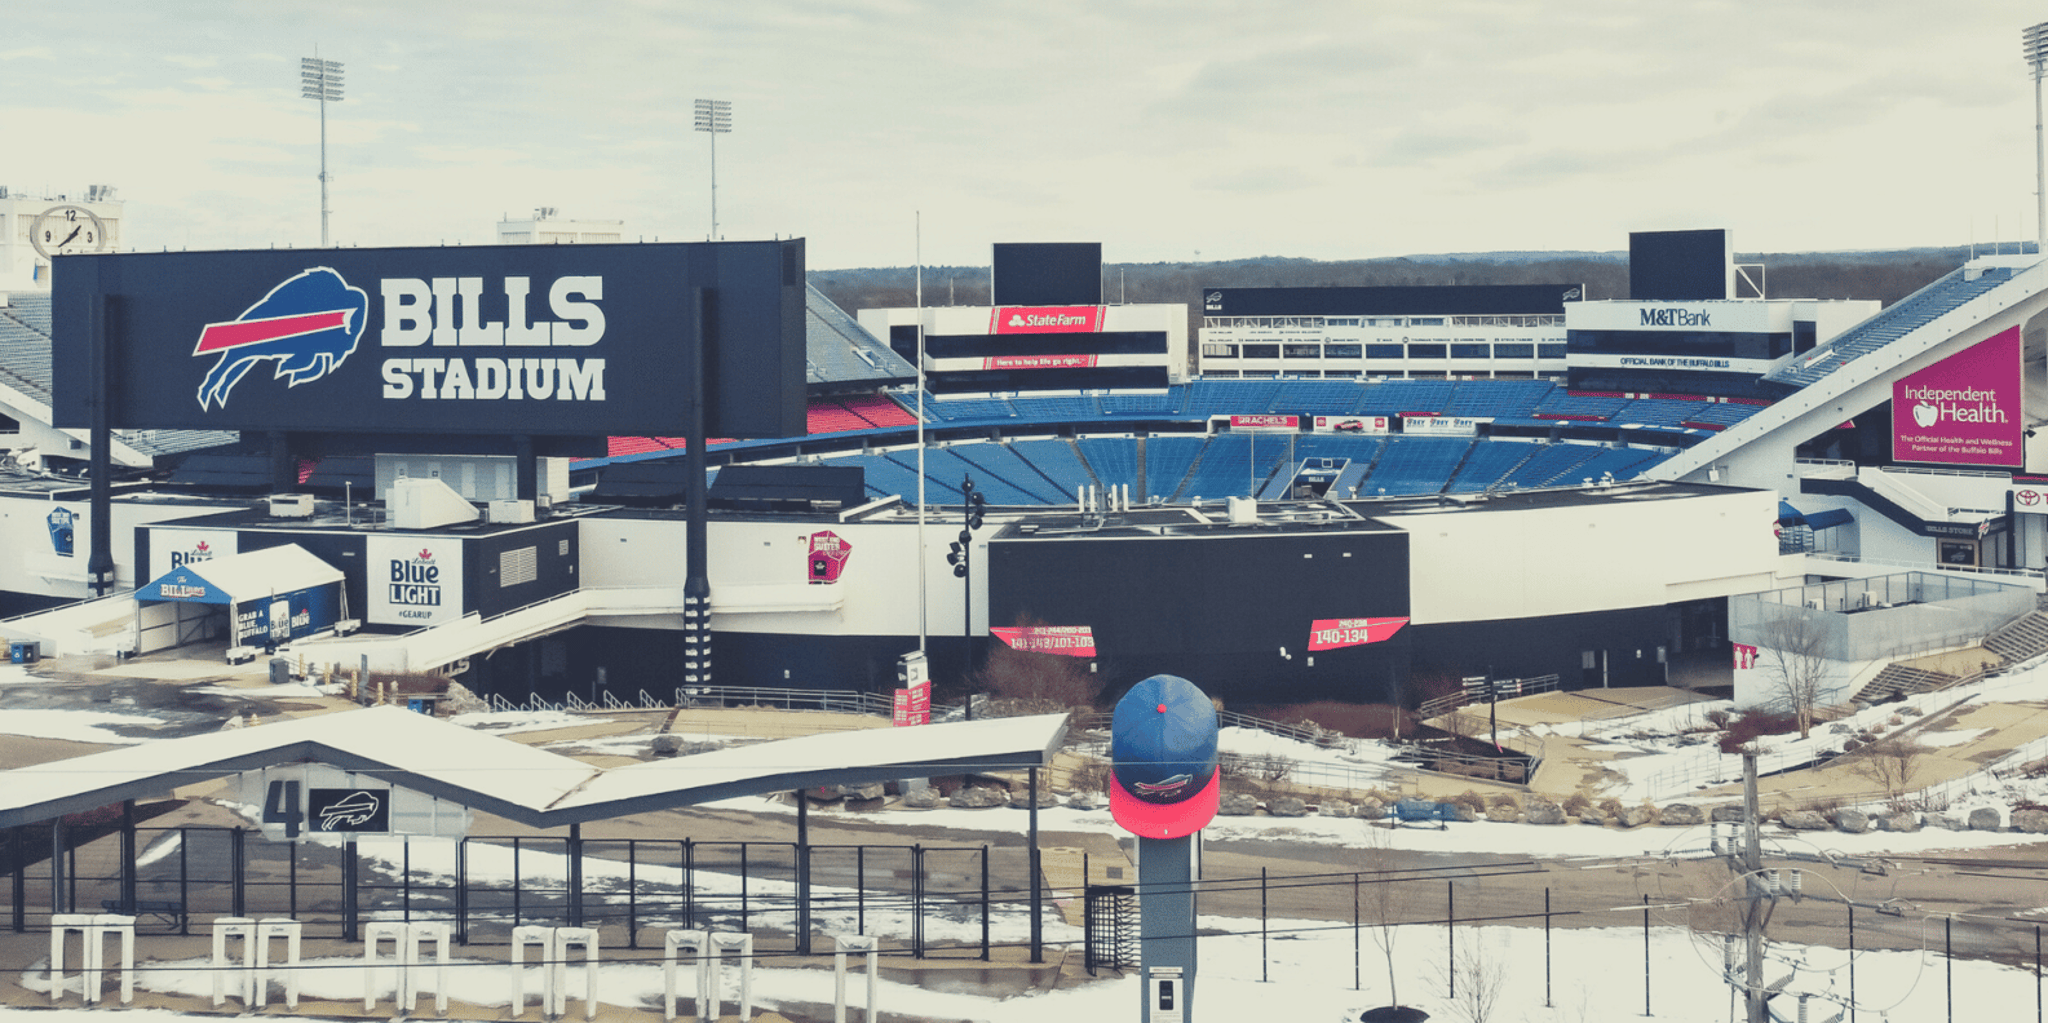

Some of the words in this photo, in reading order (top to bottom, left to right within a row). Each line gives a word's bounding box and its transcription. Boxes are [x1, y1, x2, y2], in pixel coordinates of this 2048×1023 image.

[65, 209, 76, 221] 12
[45, 231, 51, 242] 9
[87, 231, 93, 243] 3
[381, 275, 606, 346] BILLS
[997, 358, 1013, 366] Here
[1015, 358, 1022, 366] to
[1023, 358, 1038, 367] help
[1040, 357, 1051, 366] life
[1053, 358, 1061, 367] go
[1620, 357, 1648, 365] OFFICIAL
[1649, 358, 1667, 366] BANK
[1667, 358, 1675, 366] OF
[1677, 358, 1688, 367] THE
[1689, 359, 1714, 367] BUFFALO
[1714, 360, 1730, 368] BILLS
[382, 358, 605, 400] STADIUM
[1905, 385, 1996, 404] Independent
[1901, 434, 1913, 443] The
[1914, 435, 1939, 444] Official
[1940, 437, 1964, 445] Health
[1980, 438, 2013, 447] Wellness
[1912, 444, 1937, 453] Partner
[1939, 445, 1947, 453] of
[1948, 445, 1960, 453] the
[1961, 446, 1987, 455] Buffalo
[1988, 447, 2003, 456] Bills
[391, 559, 439, 583] Blue
[391, 585, 439, 604] LIGHT
[239, 611, 257, 622] GRAB
[258, 609, 264, 618] A
[399, 610, 432, 619] #GEARUP
[1316, 629, 1368, 644] 140-134
[263, 780, 304, 838] 4
